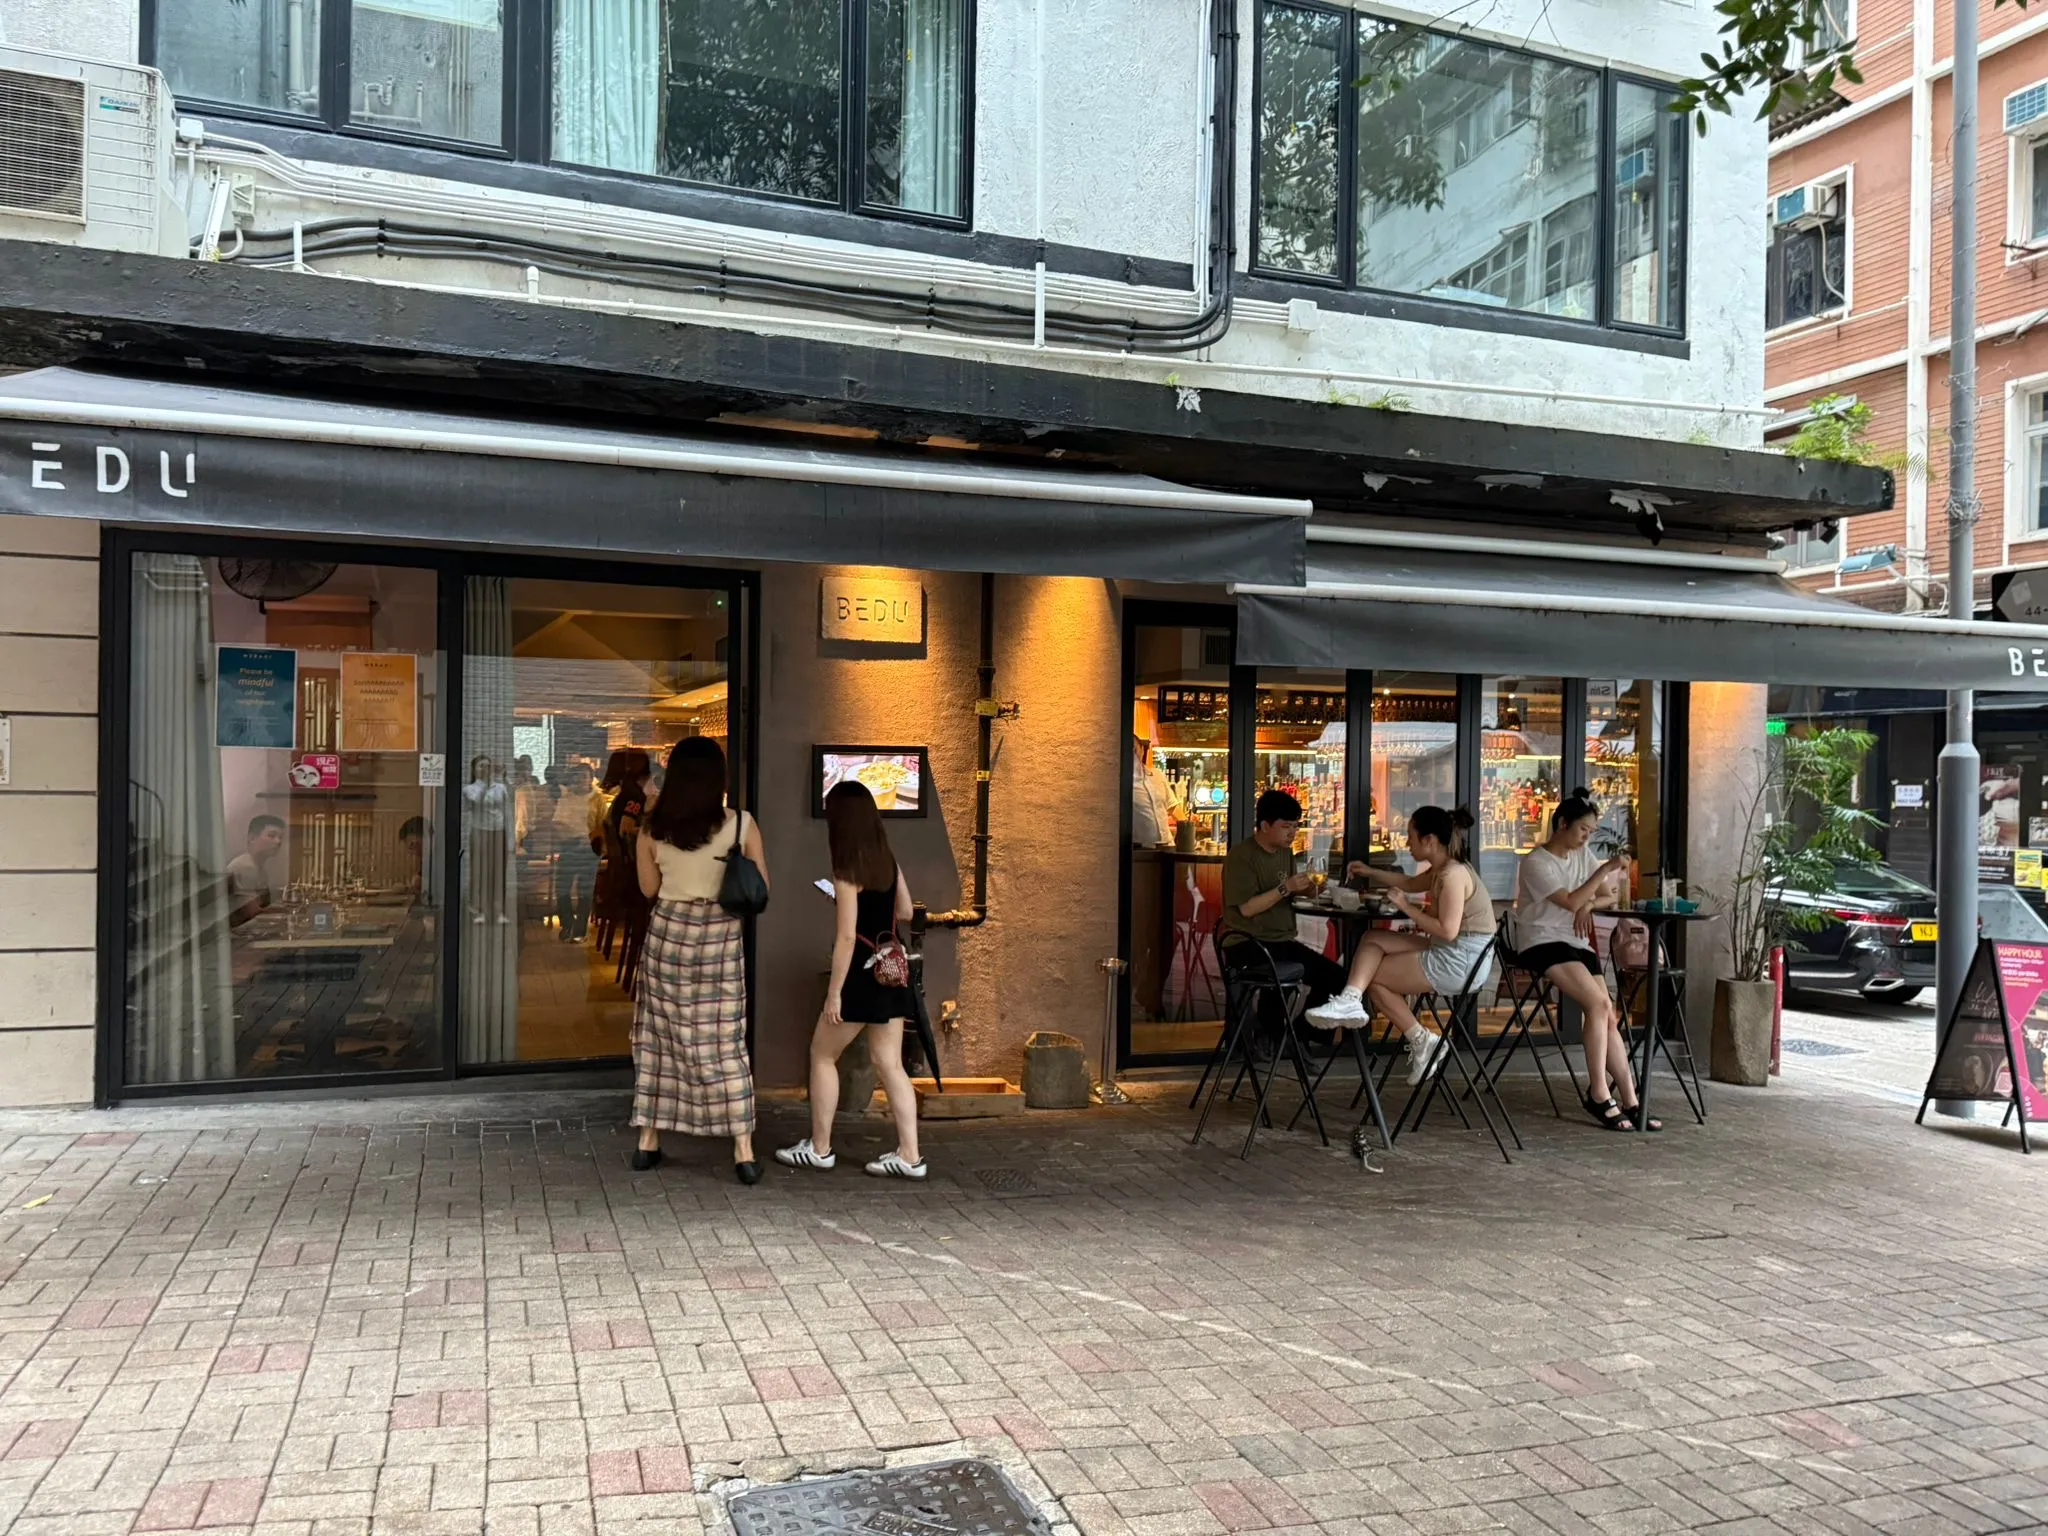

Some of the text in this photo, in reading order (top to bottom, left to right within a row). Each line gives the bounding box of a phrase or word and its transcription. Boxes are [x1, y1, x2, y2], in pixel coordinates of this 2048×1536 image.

[31, 442, 196, 498] EDU
[836, 596, 909, 623] BEDU
[2008, 647, 2048, 677] BE
[238, 677, 275, 688] mindful
